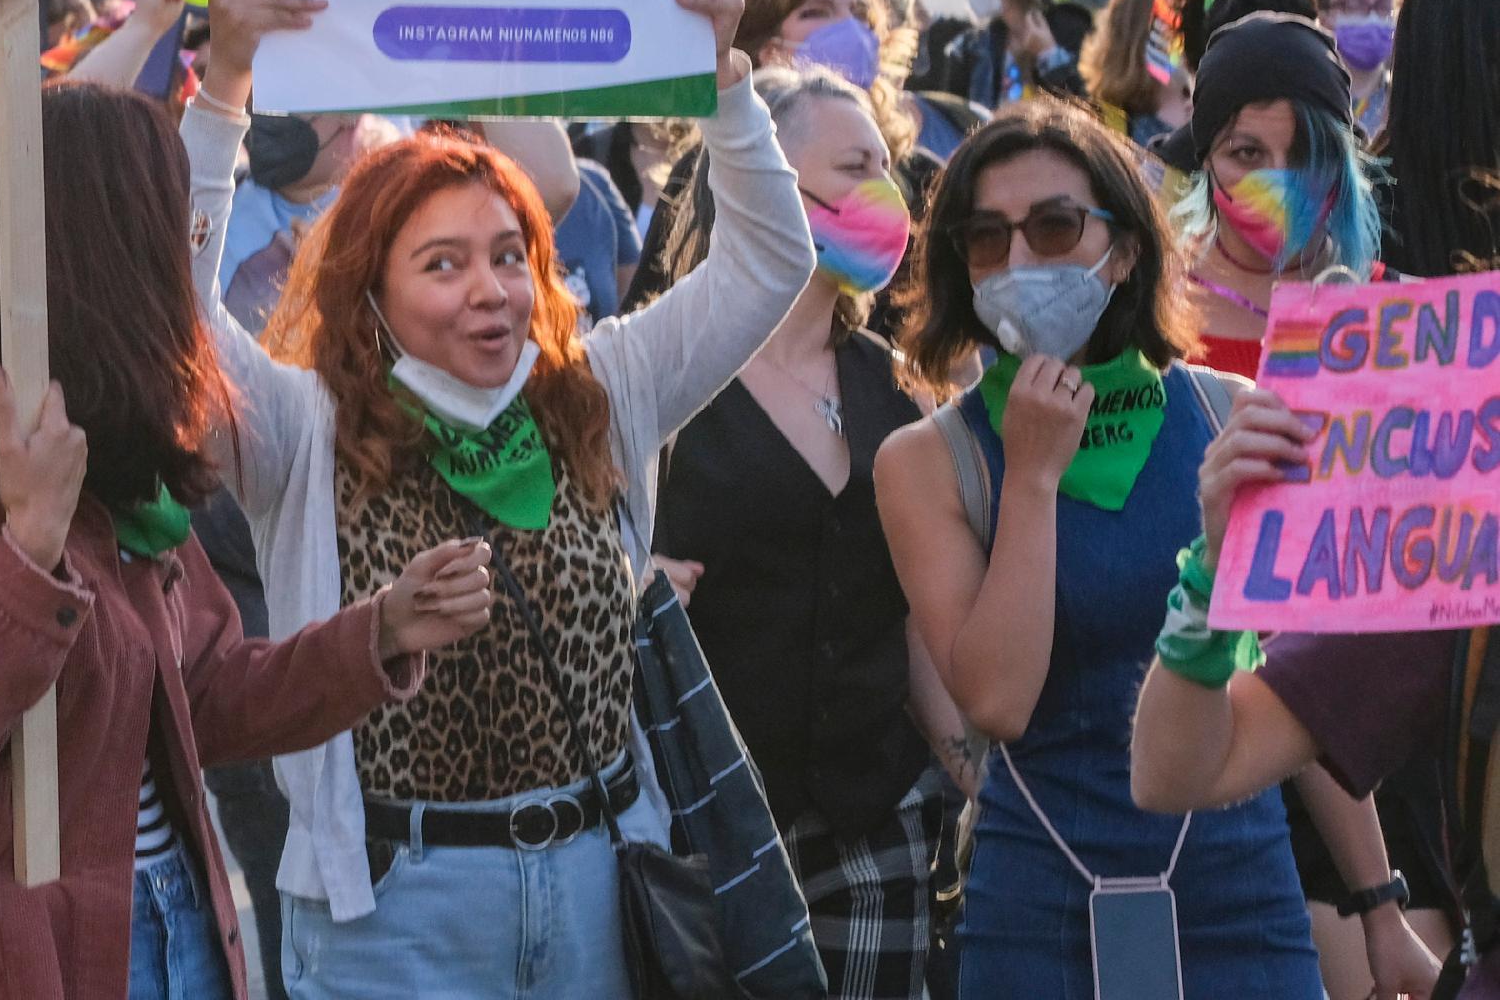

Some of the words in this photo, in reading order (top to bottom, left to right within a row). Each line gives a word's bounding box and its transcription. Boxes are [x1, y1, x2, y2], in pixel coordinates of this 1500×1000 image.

[398, 24, 493, 42] INSTAGRAM
[499, 26, 588, 44] NIUNAMENOS
[1318, 290, 1500, 374] GEND
[1243, 504, 1500, 602] LANGUA
